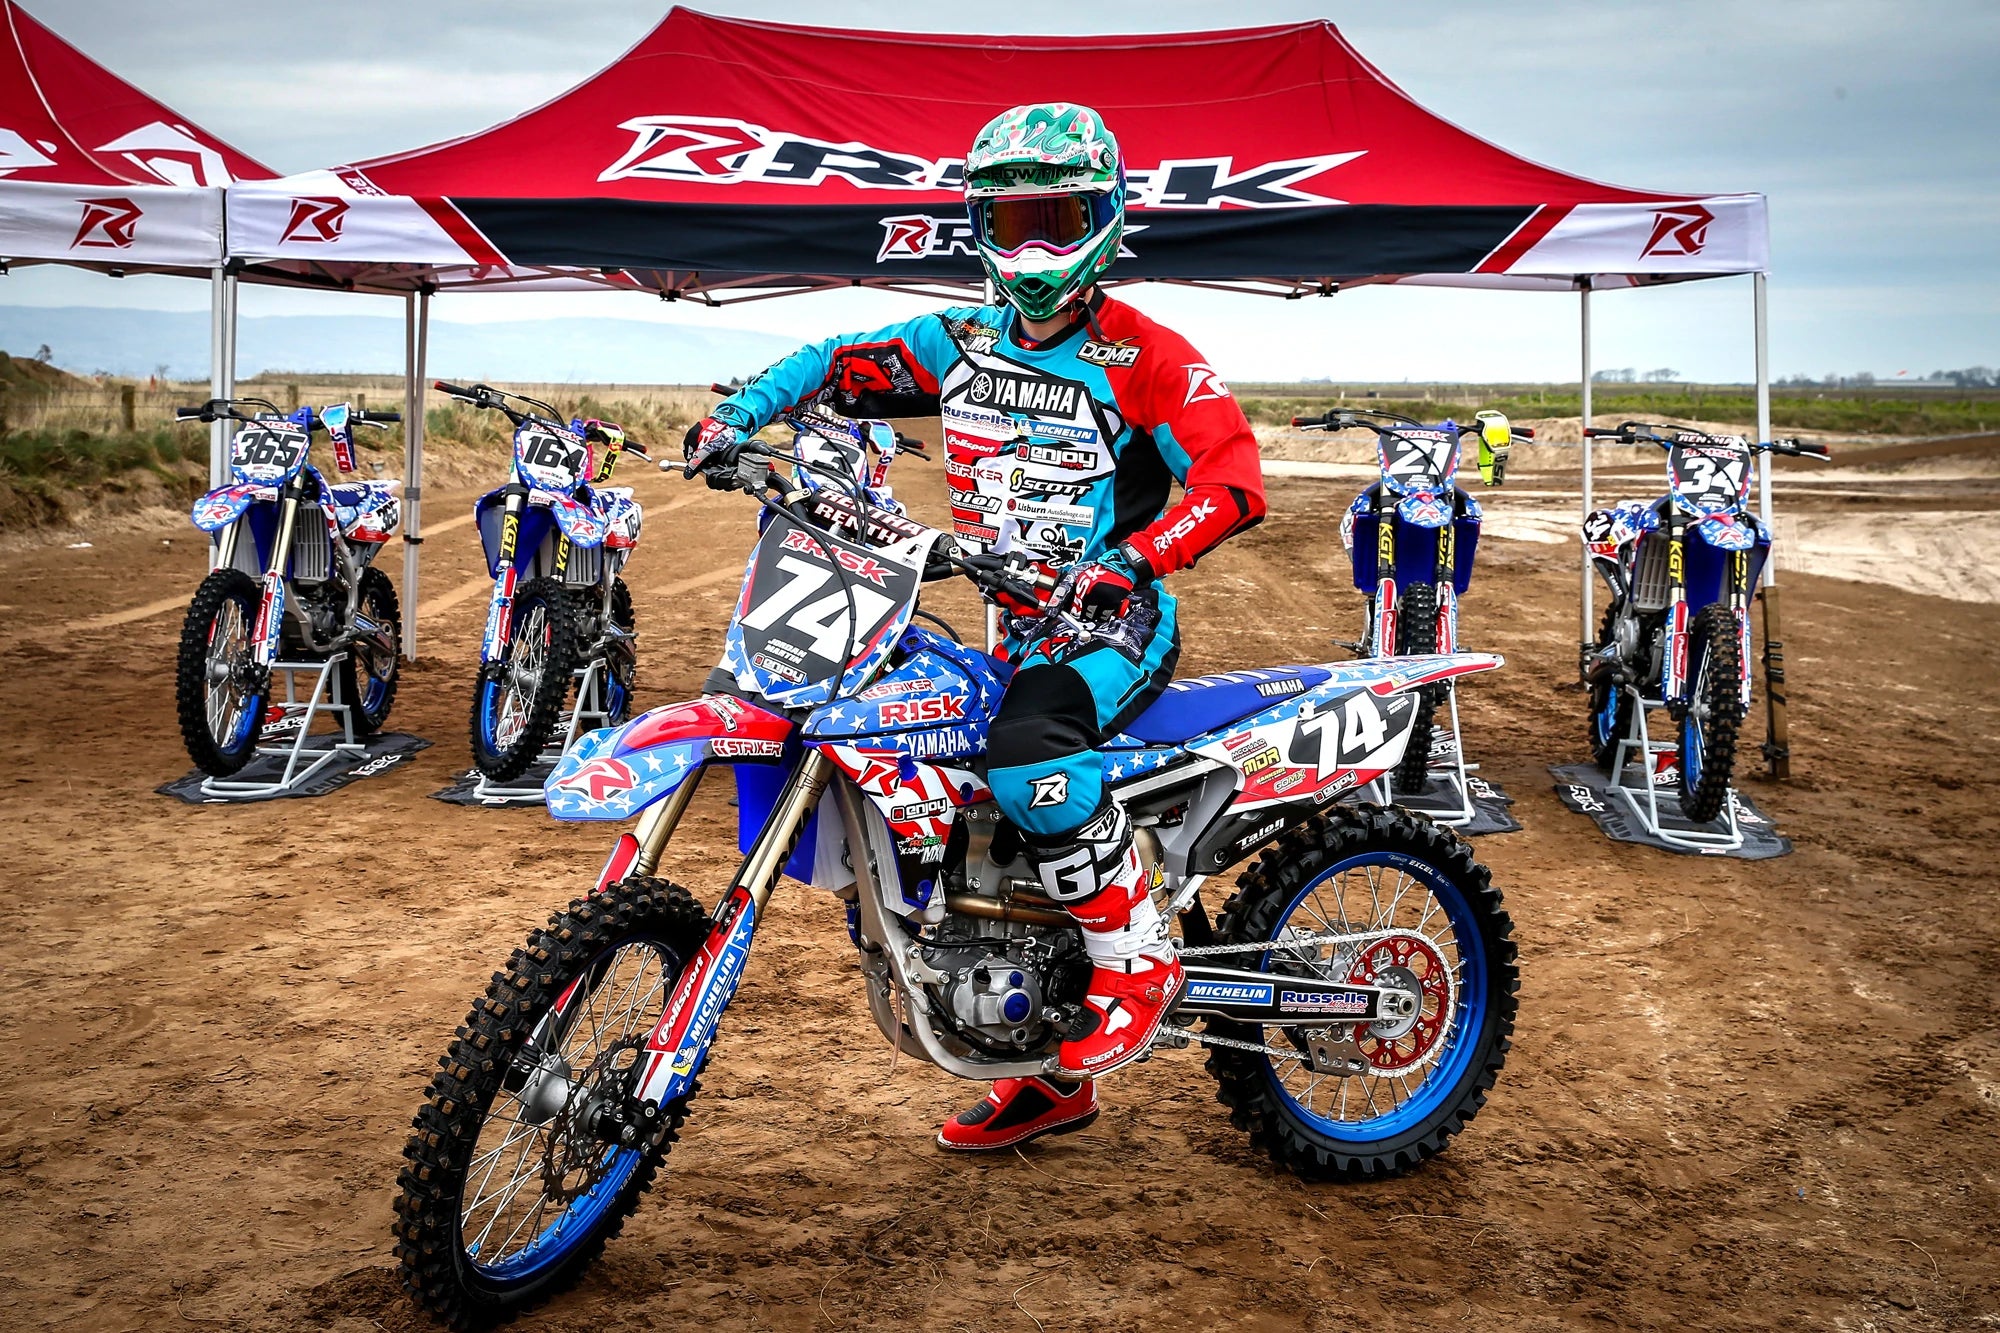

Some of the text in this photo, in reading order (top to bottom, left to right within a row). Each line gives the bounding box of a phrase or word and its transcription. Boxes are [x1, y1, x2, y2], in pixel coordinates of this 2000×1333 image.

[979, 165, 1086, 181] SHOWTIME
[967, 336, 998, 354] MX
[1078, 342, 1140, 363] DOMA
[993, 377, 1076, 414] YAMAHA
[947, 434, 996, 453] Polisport
[1034, 424, 1093, 439] MICHELIN
[232, 433, 306, 468] 365
[523, 436, 585, 475] 164
[1030, 446, 1096, 468] enjoy
[1388, 440, 1452, 475] 21
[951, 463, 1003, 484] STRIKER
[1022, 479, 1091, 495] SCOTT
[1678, 457, 1744, 496] 34
[819, 490, 922, 536] RENTHA
[1018, 503, 1046, 514] Lisburn
[504, 514, 519, 558] KGT
[815, 503, 905, 545] RENTH
[1379, 523, 1393, 566] KGT
[1670, 540, 1683, 583] KGT
[270, 598, 281, 635] MICHELIN
[738, 555, 896, 664] 74
[764, 644, 803, 665] MARTIN
[767, 638, 808, 658] JORDAN
[764, 656, 805, 683] enjoy
[878, 678, 934, 698] STRIKER
[1257, 678, 1304, 697] YAMAHA
[879, 695, 969, 727] RISK
[727, 740, 782, 757] STRIKER
[906, 730, 967, 757] YAMAHA
[1300, 691, 1388, 783] 74
[1243, 747, 1281, 775] MDR
[1323, 772, 1356, 794] enjoy
[906, 799, 947, 819] enjoy
[1235, 818, 1285, 847] Talon
[1409, 859, 1434, 875] EXCEL
[657, 955, 705, 1046] Polisport
[689, 951, 737, 1043] MICHELIN
[1190, 985, 1267, 999] MICHELIN
[1281, 990, 1368, 1004] Russells
